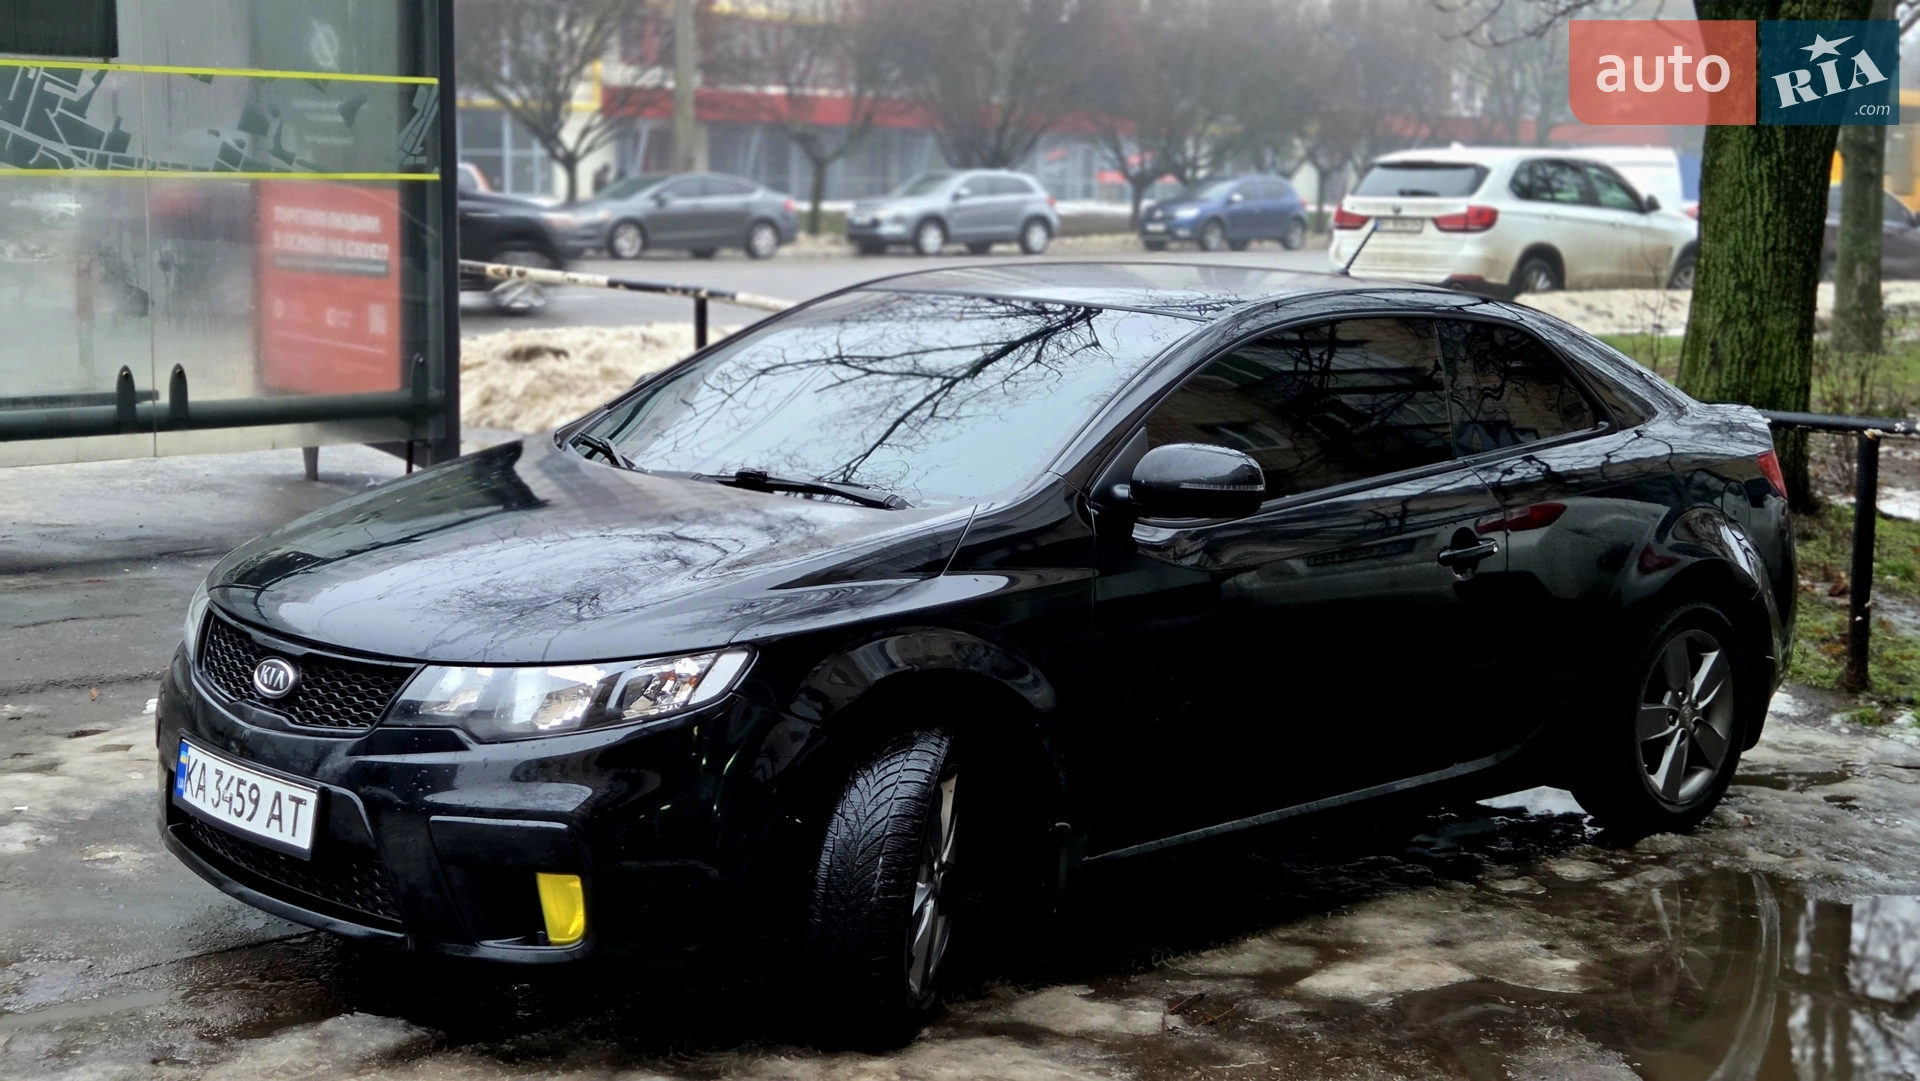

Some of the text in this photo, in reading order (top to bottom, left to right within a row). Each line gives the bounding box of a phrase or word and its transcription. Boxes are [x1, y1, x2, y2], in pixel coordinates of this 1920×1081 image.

[260, 664, 285, 690] KIA
[185, 755, 307, 838] KA 3459 AT
